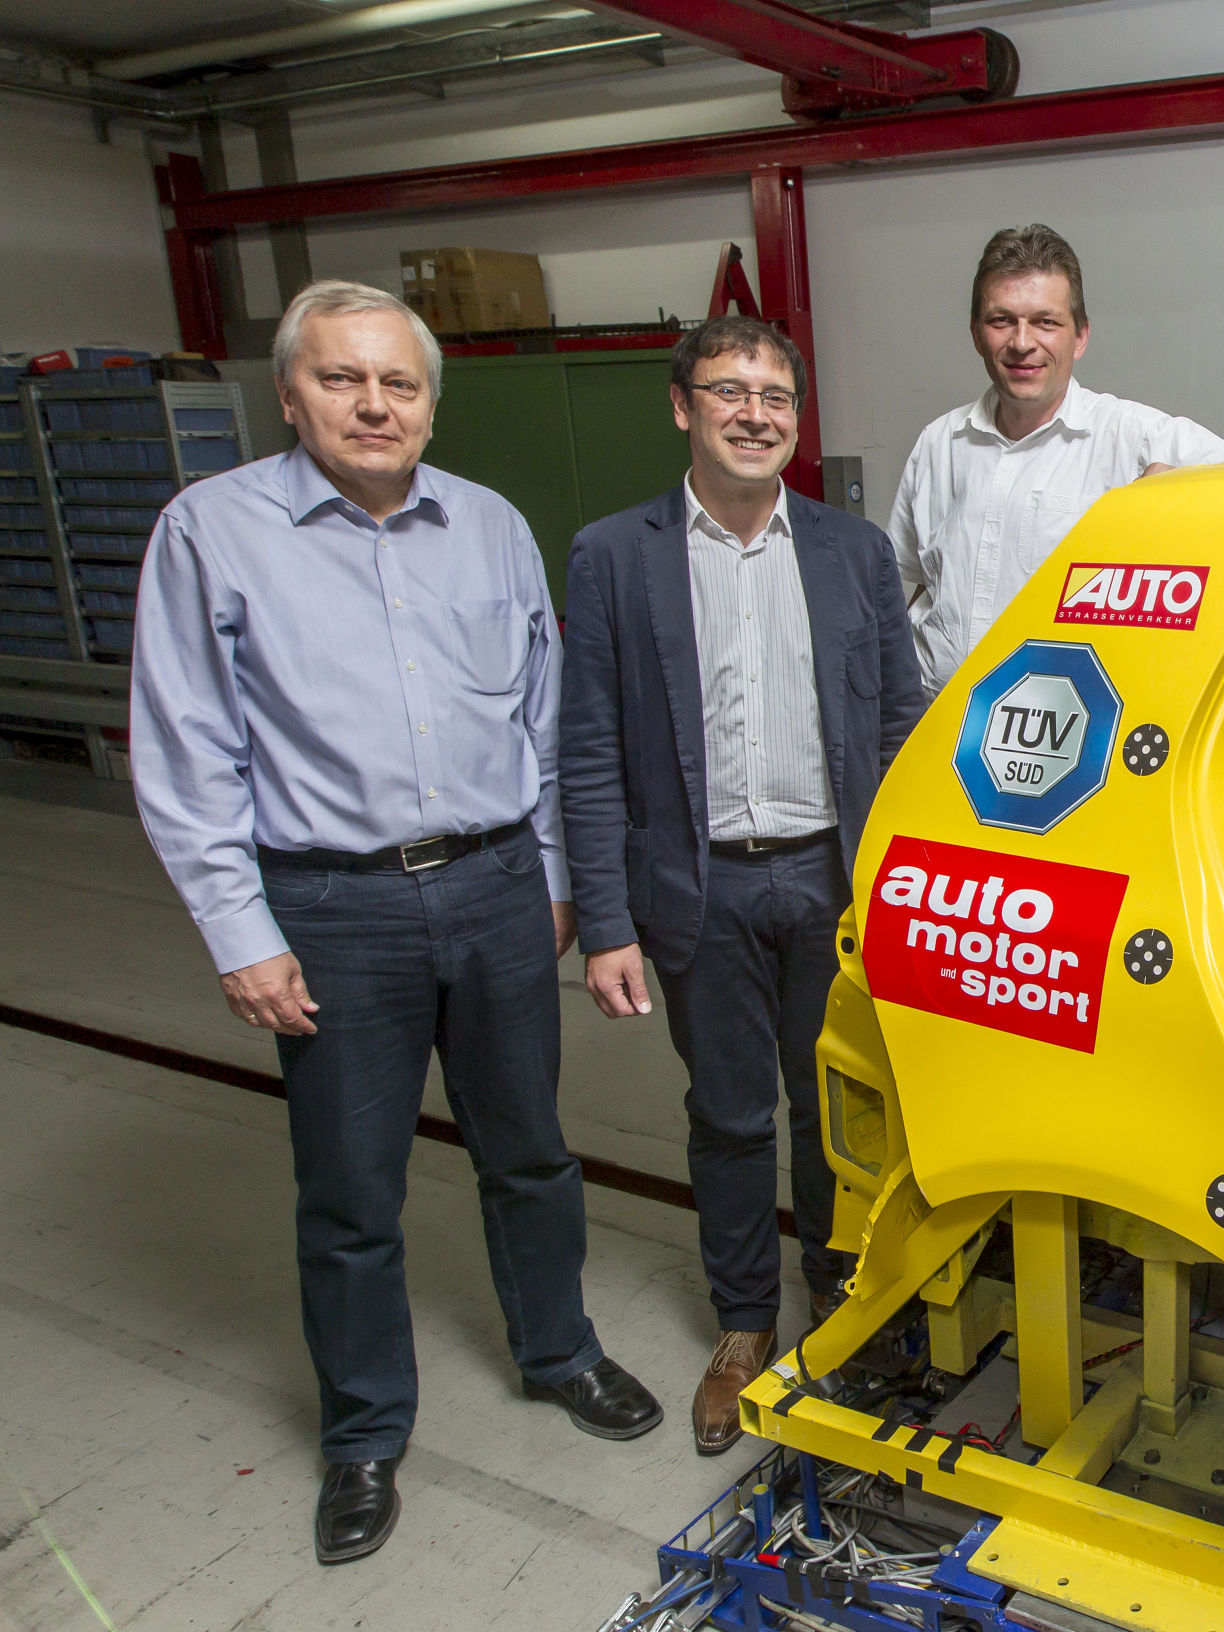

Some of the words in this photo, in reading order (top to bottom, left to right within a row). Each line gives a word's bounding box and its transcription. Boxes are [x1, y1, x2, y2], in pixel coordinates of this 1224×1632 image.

[1062, 568, 1202, 615] AUTO
[1058, 611, 1192, 625] STRASSENVERKEHR
[1000, 705, 1079, 751] TÜV
[1004, 760, 1044, 785] SÜD
[880, 865, 1054, 934] auto
[906, 918, 1079, 980] motor
[940, 967, 957, 980] und
[960, 969, 1090, 1023] sport
